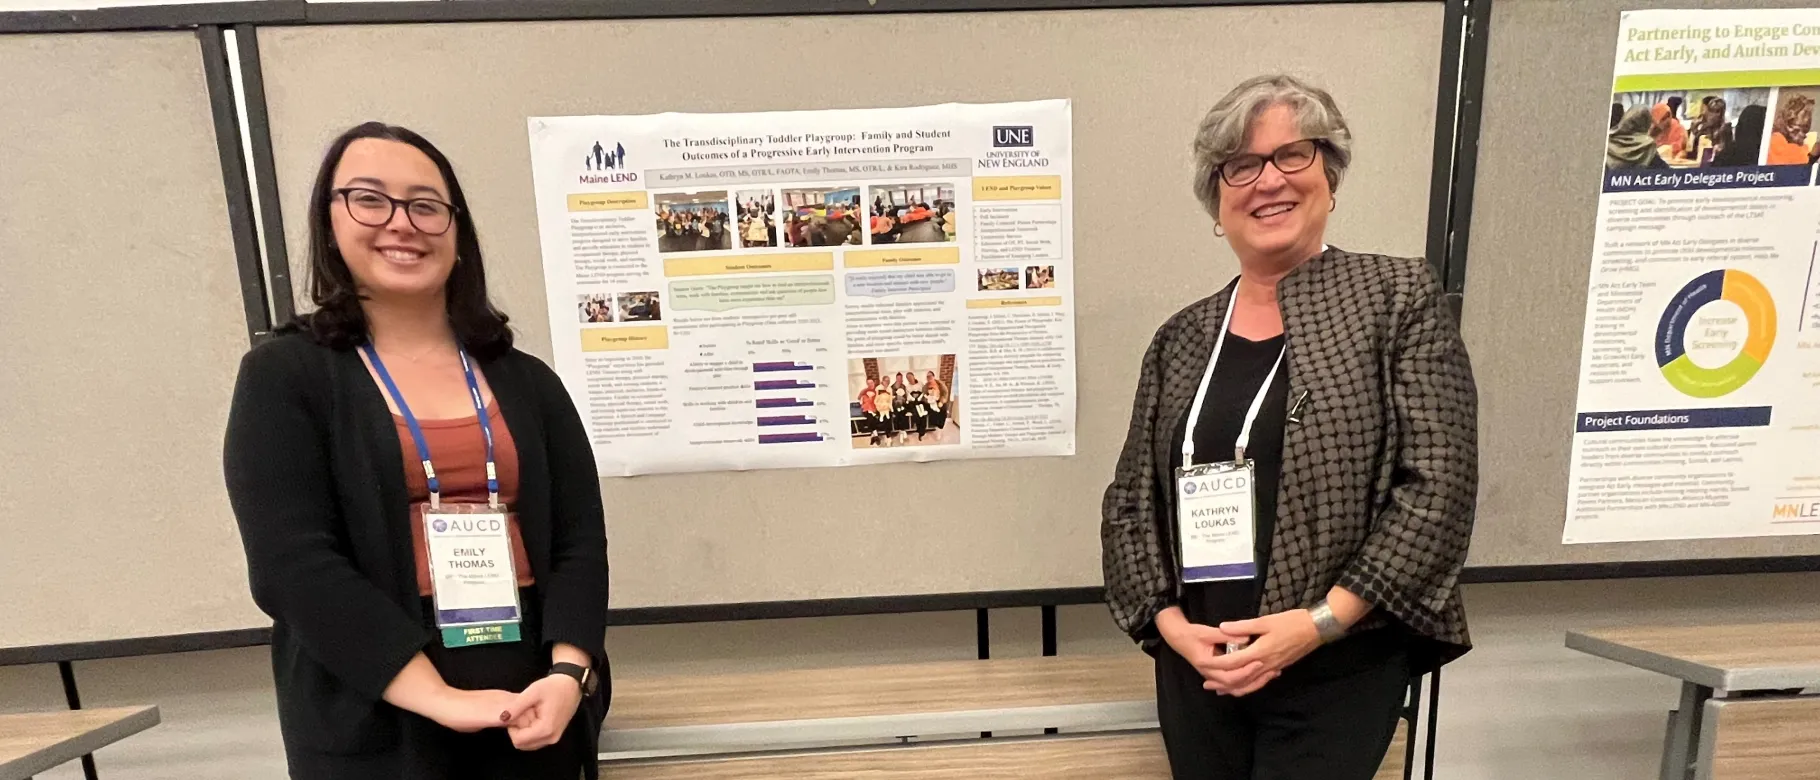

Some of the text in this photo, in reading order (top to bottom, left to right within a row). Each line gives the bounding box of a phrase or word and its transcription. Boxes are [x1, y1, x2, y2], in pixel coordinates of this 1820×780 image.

[1627, 26, 1711, 42] Partnering
[1715, 26, 1729, 38] to
[1734, 24, 1789, 40] Engage
[1624, 48, 1649, 62] Act
[1652, 46, 1698, 63] Early,
[1702, 45, 1731, 59] and
[1733, 43, 1788, 58] Autism
[663, 128, 951, 148] The Transdisciplinary Toddler Playgroup: Family and Student
[995, 128, 1030, 145] UNE
[682, 150, 729, 161] Outcomes
[731, 149, 741, 159] of
[750, 147, 803, 160] Progressive
[805, 145, 831, 158] Early
[834, 144, 894, 155] Intervention
[896, 142, 934, 155] Program
[986, 149, 1041, 158] UNIVERSITY OF
[978, 157, 1049, 168] NEW ENGLAND
[579, 172, 638, 184] Maine LEND
[1611, 170, 1774, 188] MN Act Early Delegate Project
[1699, 316, 1738, 325] Increase
[1704, 328, 1729, 338] Early
[1691, 340, 1738, 351] Screening
[1585, 413, 1690, 429] Project Foundations
[1199, 477, 1246, 493] AUCD
[1191, 505, 1239, 518] KATHRYN
[450, 519, 501, 532] AUCD
[1195, 517, 1237, 529] LOUKAS
[453, 548, 486, 557] EMILY
[447, 559, 495, 569] THOMAS
[463, 625, 503, 636] FIRST TIME
[466, 634, 503, 644] ATTENDEE
